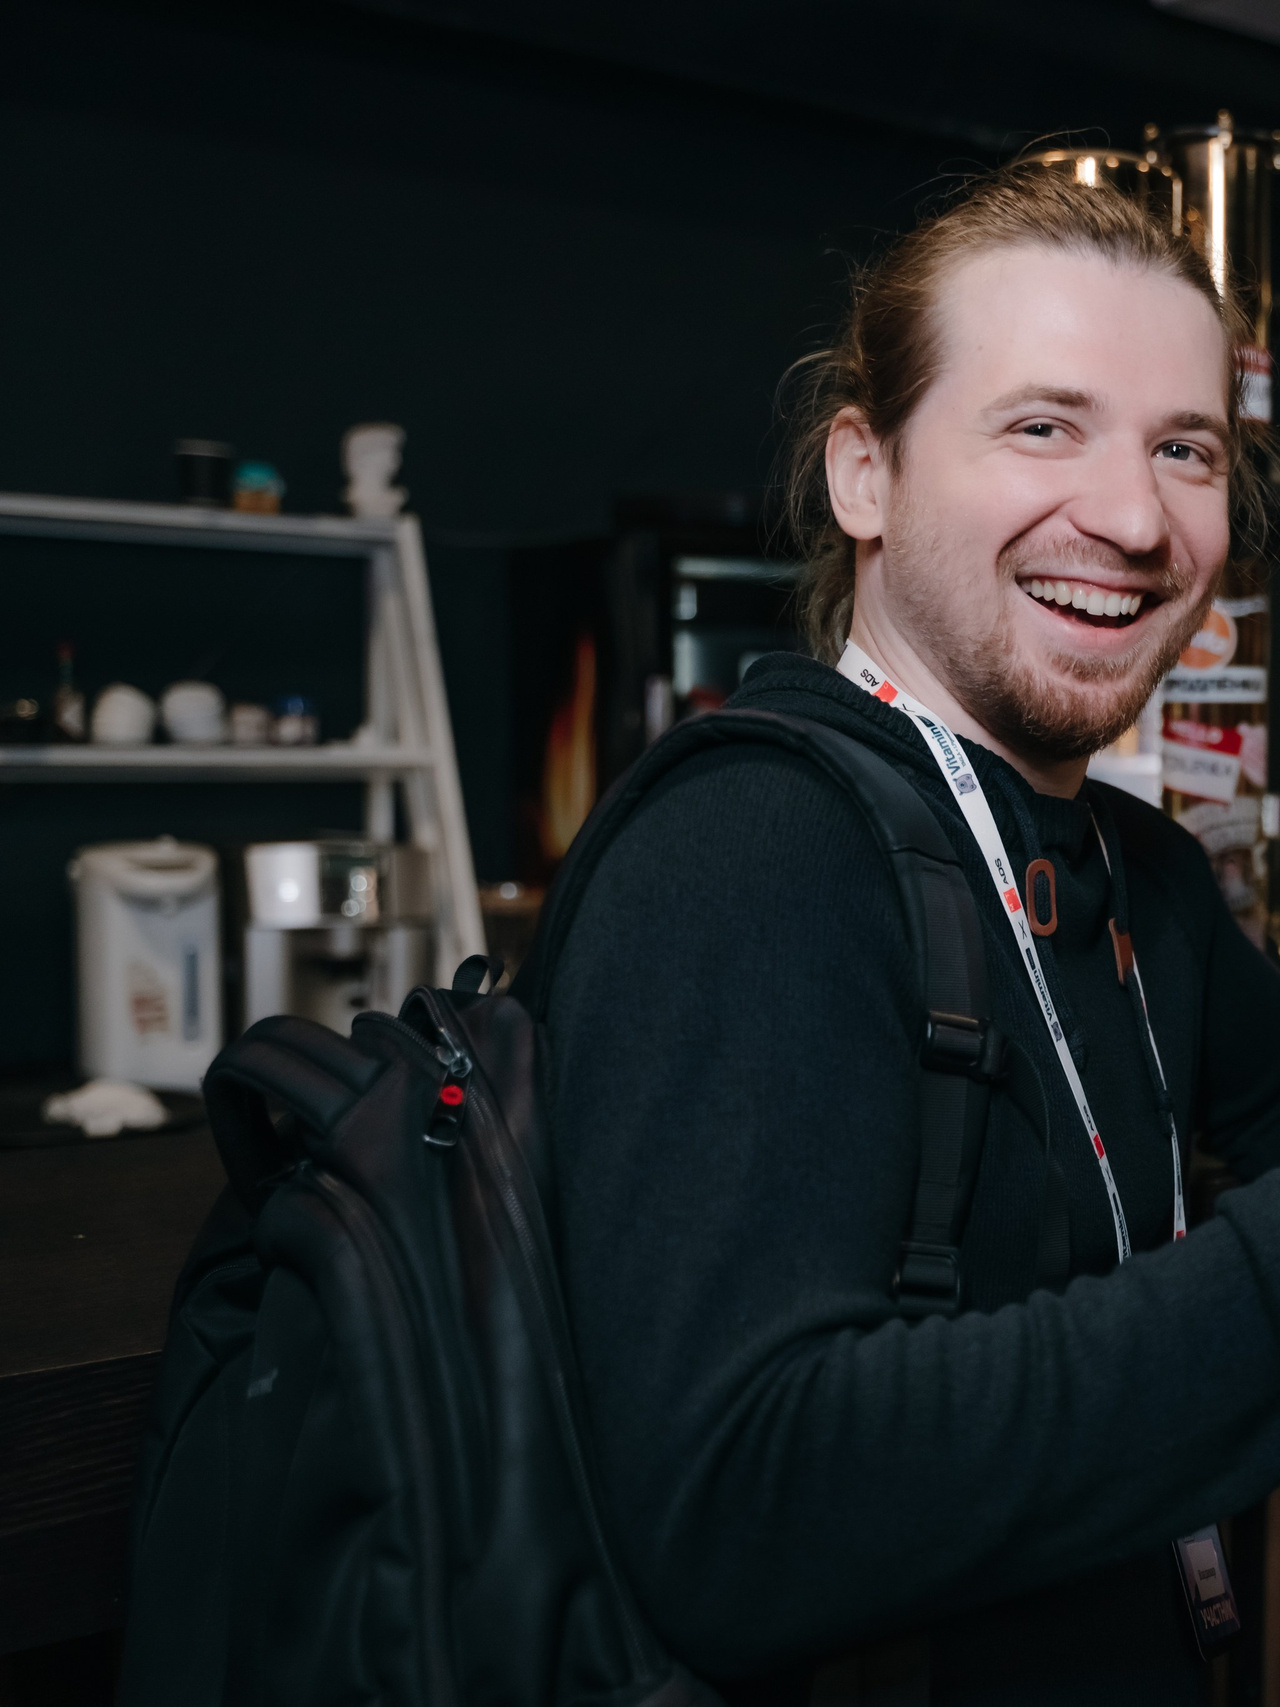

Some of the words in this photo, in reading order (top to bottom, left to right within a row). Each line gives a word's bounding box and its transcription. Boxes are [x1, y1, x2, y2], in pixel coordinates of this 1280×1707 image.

[860, 668, 880, 687] ADS
[930, 726, 961, 776] Vitamin
[994, 858, 1009, 885] ADS
[1032, 969, 1053, 1022] Vitamin
